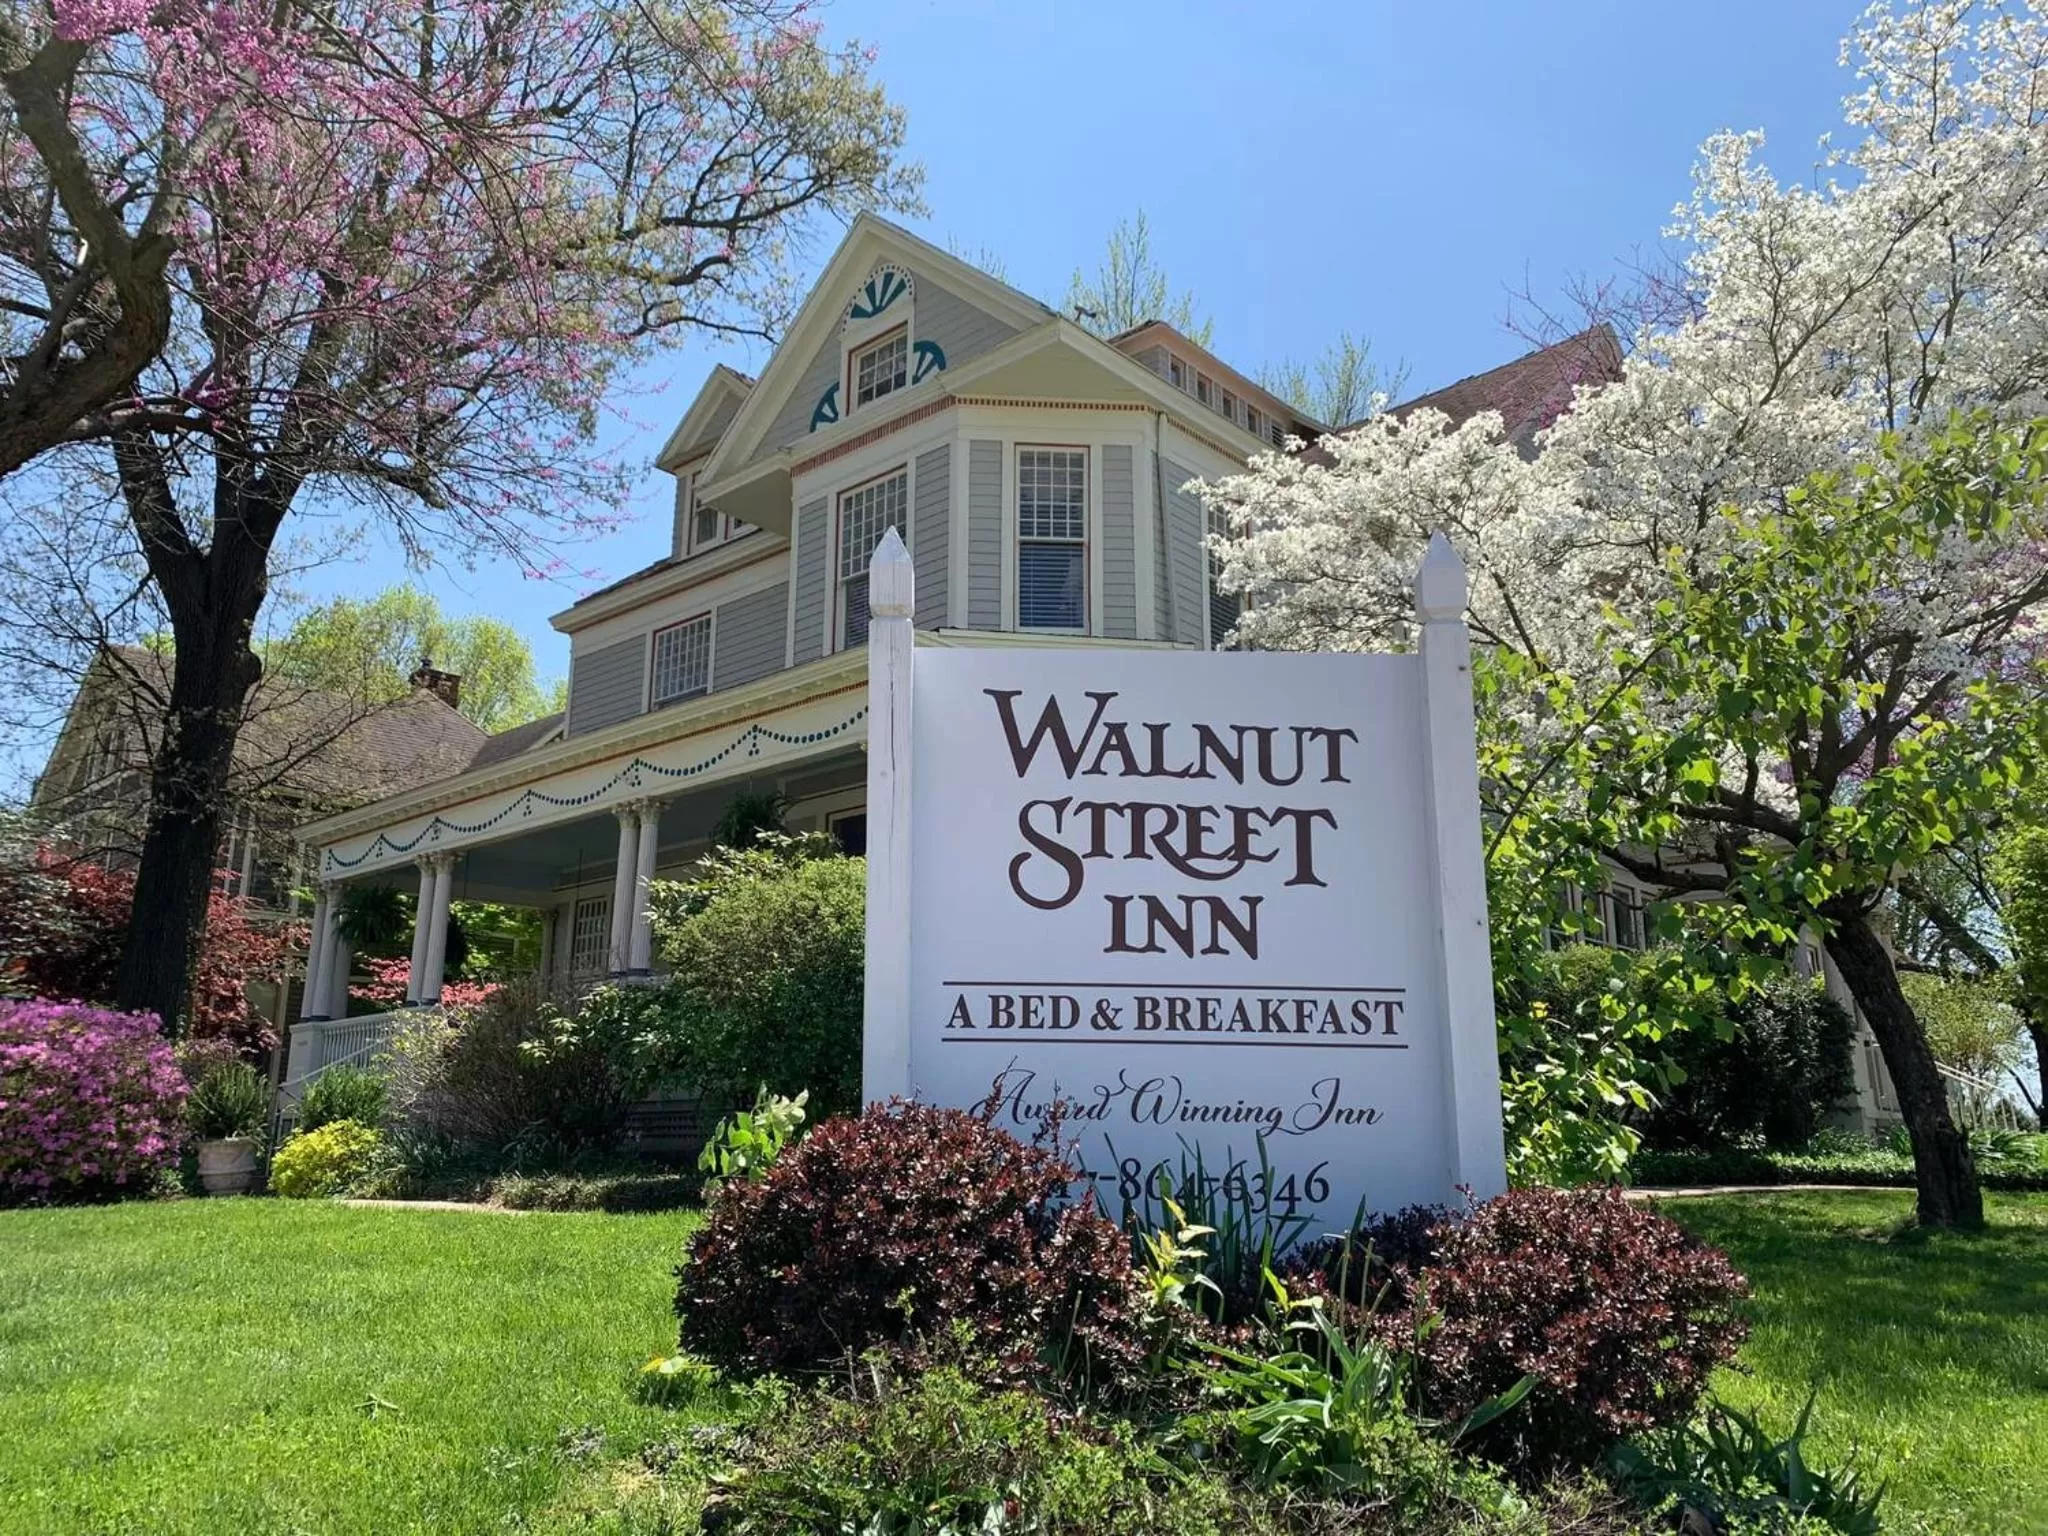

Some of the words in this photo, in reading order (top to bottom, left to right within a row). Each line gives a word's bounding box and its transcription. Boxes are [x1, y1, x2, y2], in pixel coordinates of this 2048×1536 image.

[983, 689, 1359, 787] WALNUT
[1009, 796, 1339, 910] STREET
[1103, 895, 1265, 961] INN
[945, 994, 977, 1029] A
[987, 994, 1081, 1031] BED
[1090, 998, 1123, 1031] &
[1133, 995, 1405, 1036] BREAKFAST
[1125, 1070, 1290, 1138] Winning
[1292, 1077, 1385, 1133] Inn
